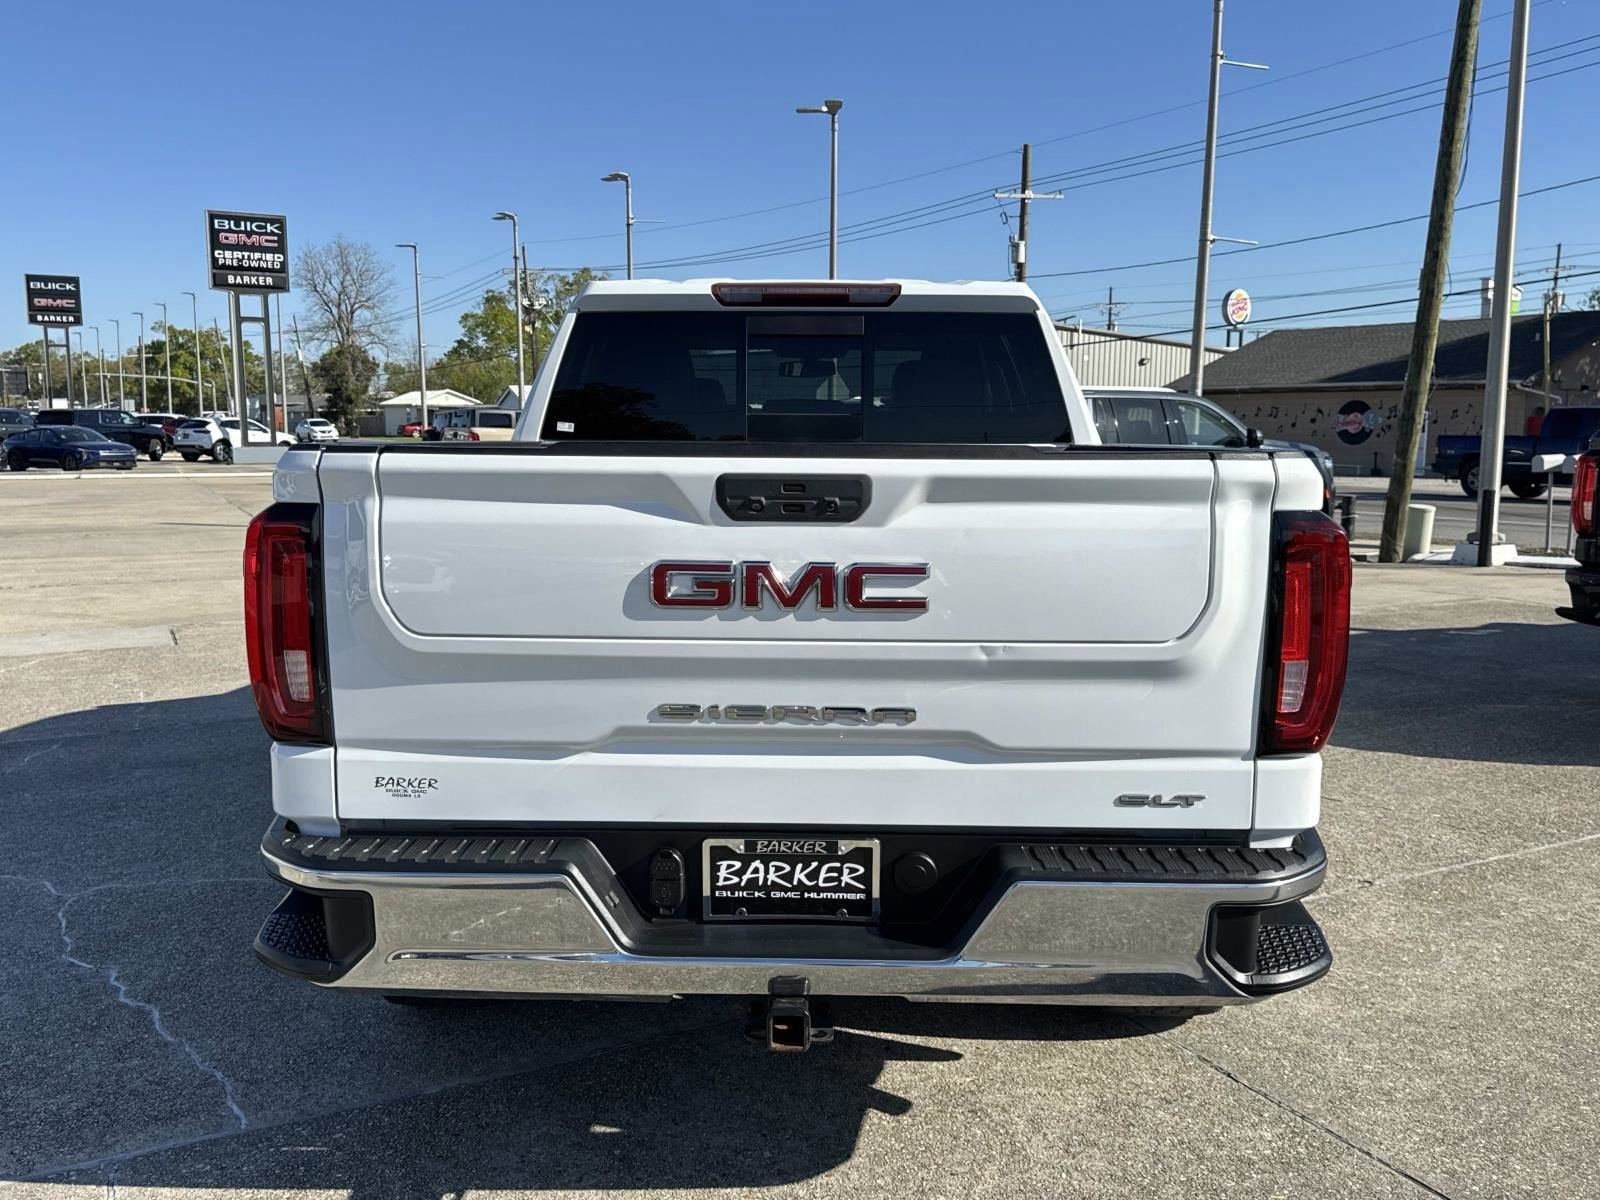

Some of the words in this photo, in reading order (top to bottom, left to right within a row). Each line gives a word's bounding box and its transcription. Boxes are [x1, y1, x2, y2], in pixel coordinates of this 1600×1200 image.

[214, 219, 282, 234] BUICK
[219, 232, 278, 247] GMC
[214, 250, 284, 262] CERTIFIED
[218, 258, 281, 269] PRE-OWNED
[30, 281, 77, 291] BUICK
[227, 274, 273, 286] BARKER
[33, 298, 76, 307] GMC
[36, 314, 74, 323] BARKER
[650, 559, 931, 612] GMC
[656, 703, 917, 723] SIERRA
[374, 776, 439, 790] BARKER
[1115, 793, 1208, 808] SLT
[755, 840, 828, 854] BARKER
[715, 859, 867, 889] BARKER
[715, 890, 767, 899] BUICK
[770, 891, 801, 899] GMC
[804, 892, 867, 900] HUMMER
